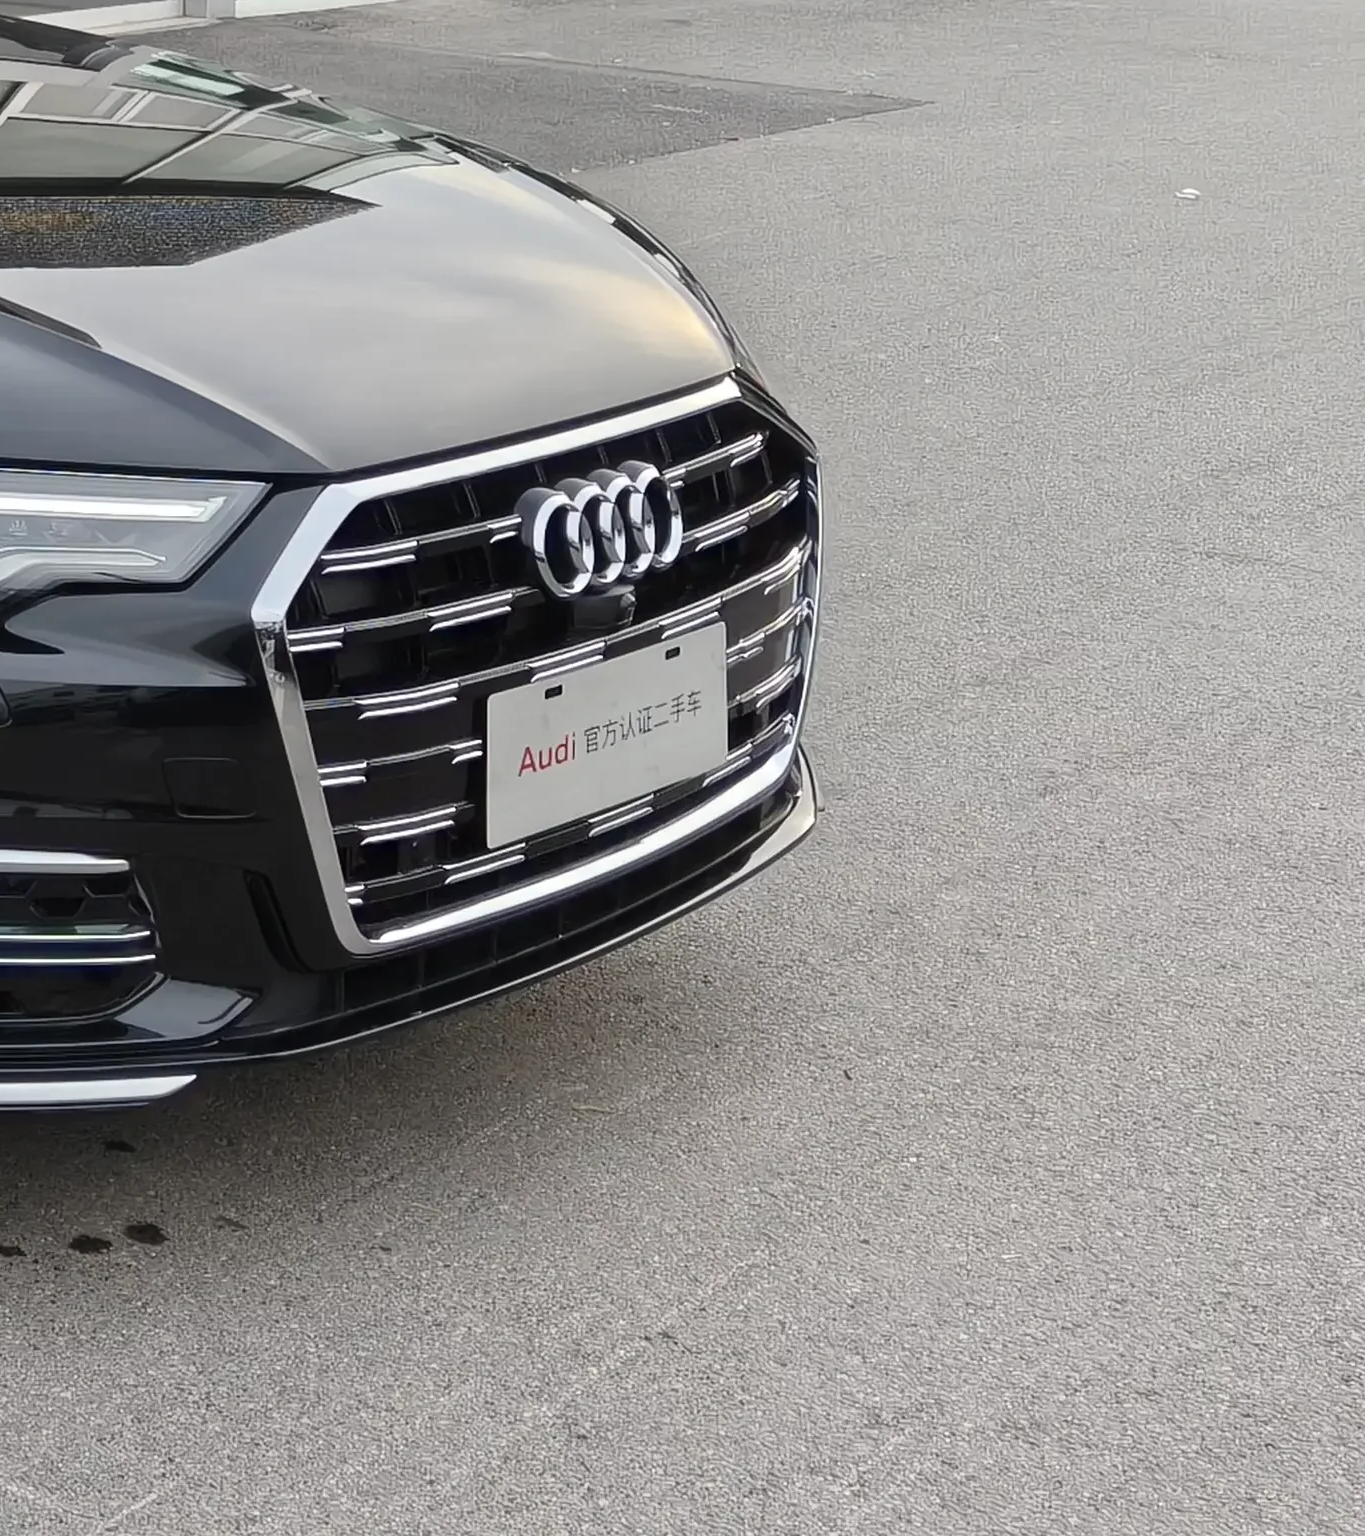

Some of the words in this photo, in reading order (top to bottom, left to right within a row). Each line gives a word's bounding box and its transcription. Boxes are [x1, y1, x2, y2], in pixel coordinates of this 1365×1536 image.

[517, 731, 577, 778] Audi
[583, 690, 703, 755] 官方认证二手车
